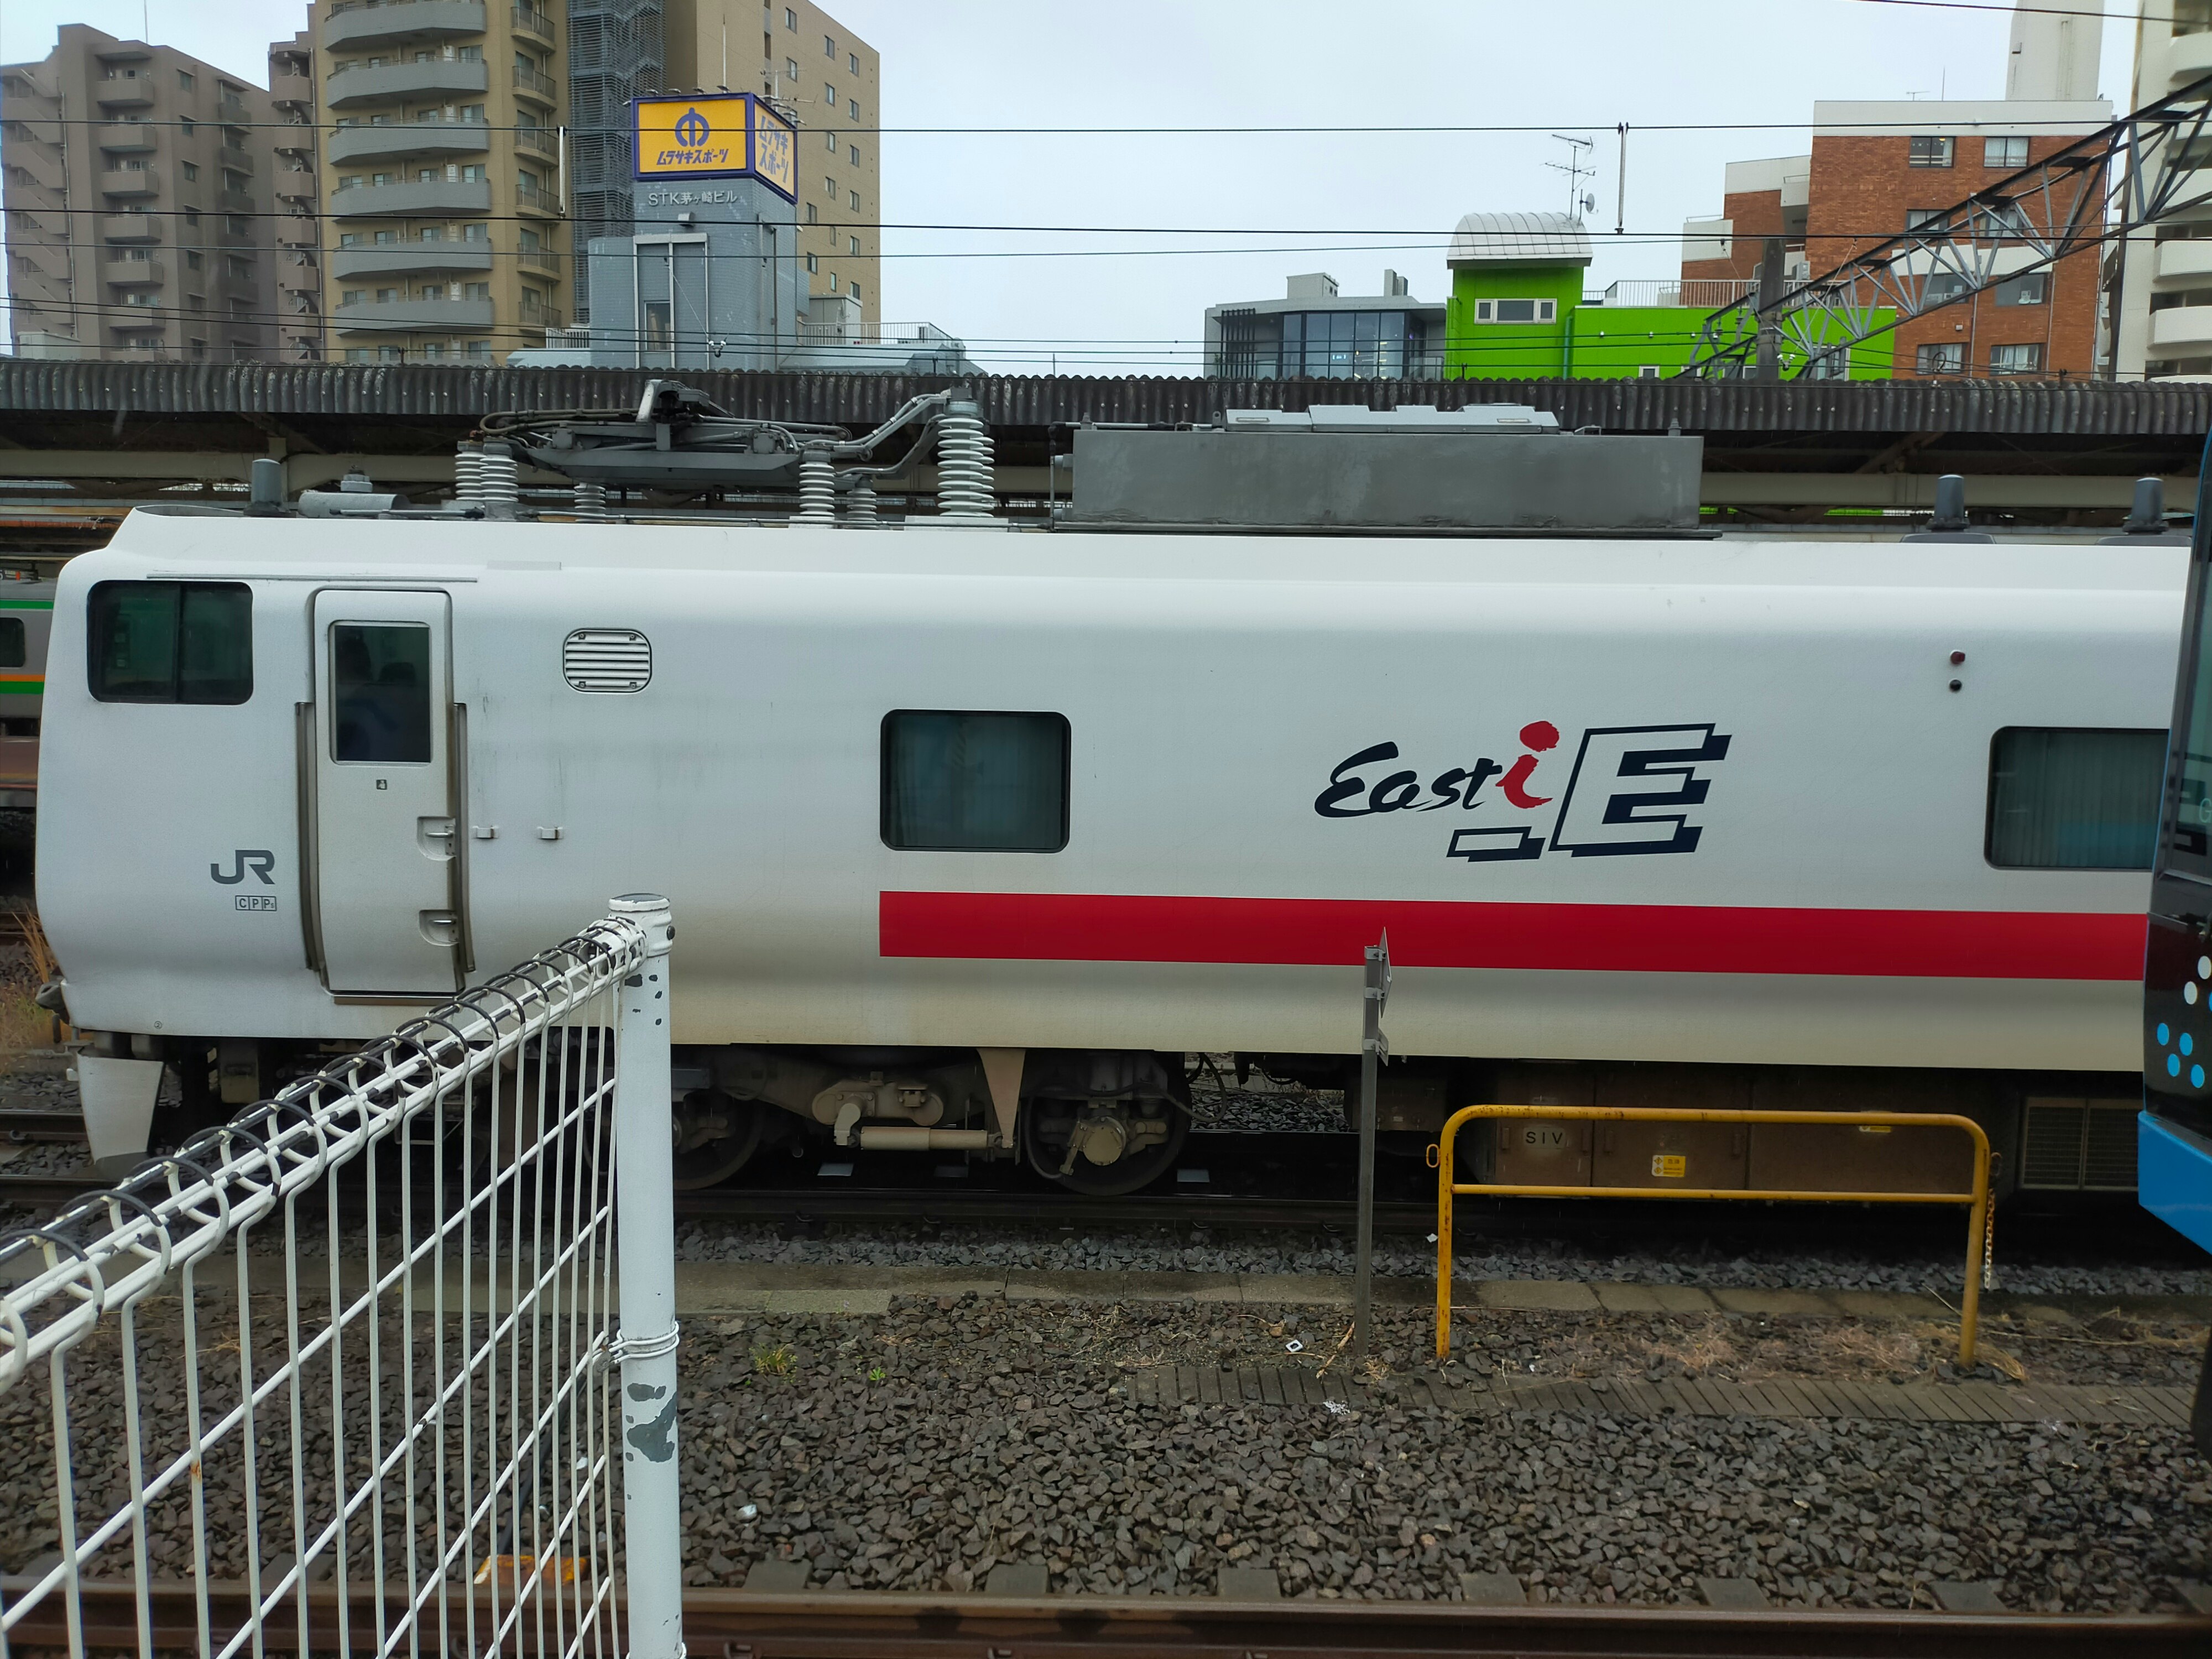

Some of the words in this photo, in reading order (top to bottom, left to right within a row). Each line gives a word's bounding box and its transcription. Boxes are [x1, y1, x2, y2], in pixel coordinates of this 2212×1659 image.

[656, 148, 729, 165] ムラサキスポーツ
[759, 143, 789, 184] スポーツ
[210, 849, 275, 885] JR
[1526, 1131, 1563, 1144] SIV
